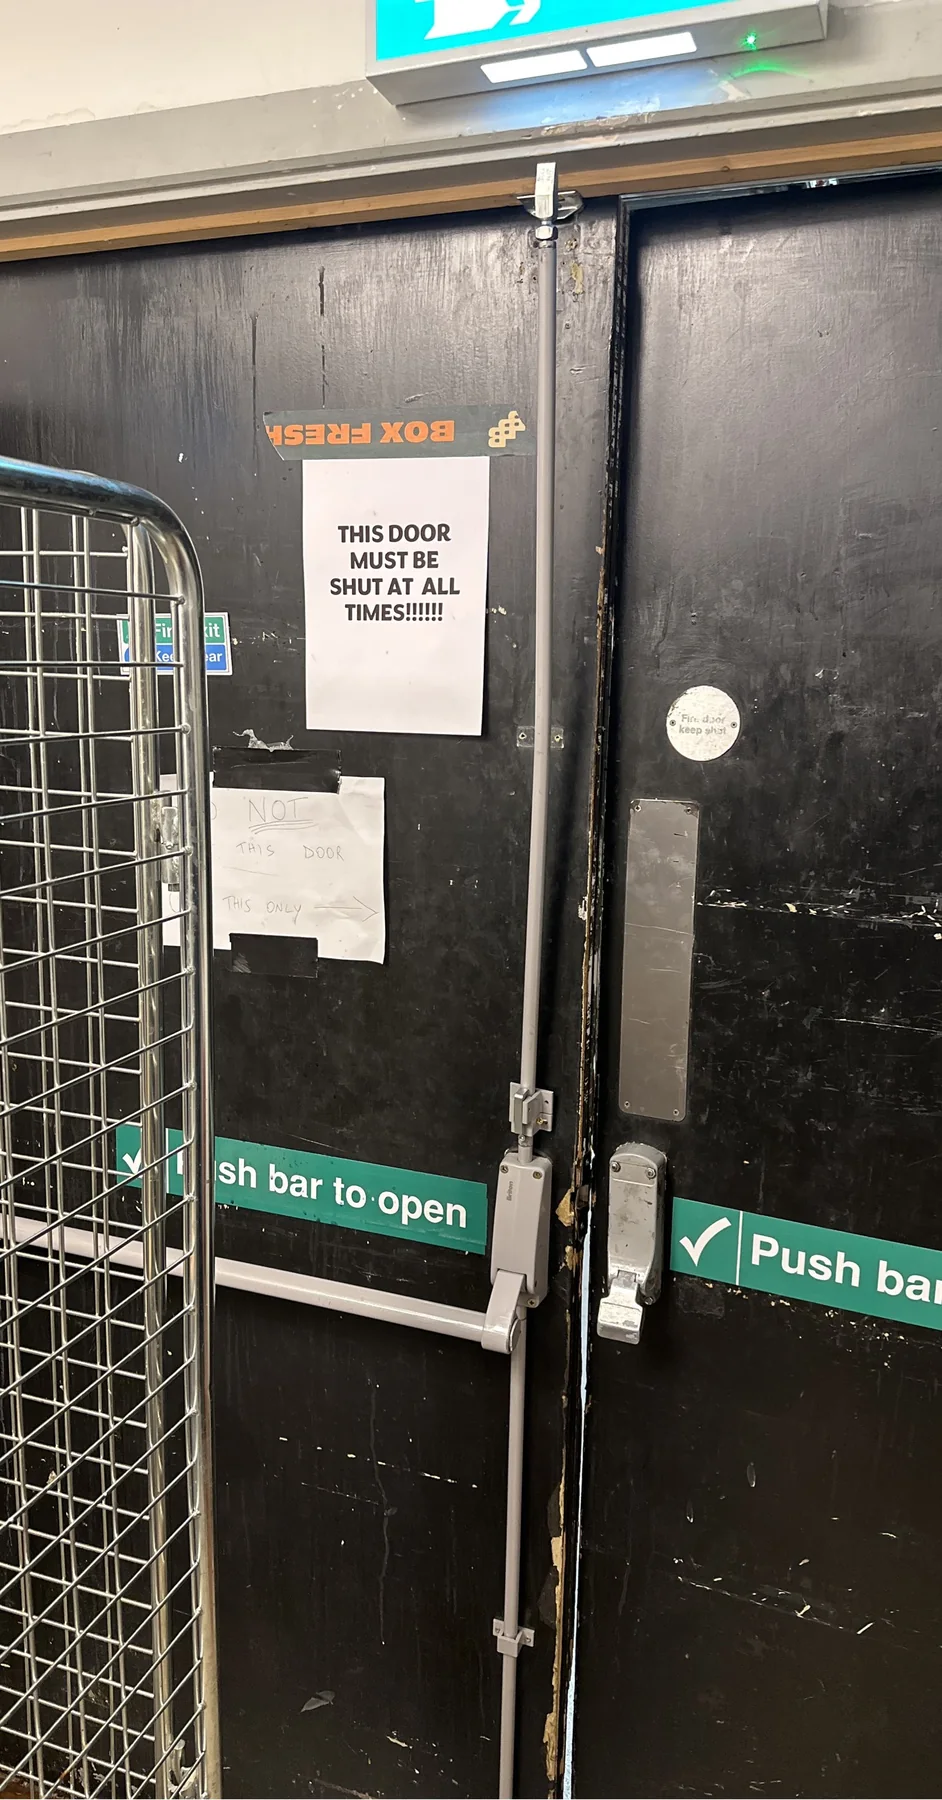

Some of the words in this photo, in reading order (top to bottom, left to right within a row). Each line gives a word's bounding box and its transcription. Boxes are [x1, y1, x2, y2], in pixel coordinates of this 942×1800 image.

[265, 422, 372, 446] FRESH
[380, 420, 455, 445] BOX
[338, 525, 384, 543] THIS
[388, 523, 451, 542] DOOR
[350, 551, 408, 570] MUST
[413, 551, 439, 569] BE
[329, 577, 383, 596] SHUT
[387, 578, 414, 595] AT
[421, 577, 461, 595] ALL
[344, 602, 444, 621] TIMES!!!!!!
[678, 725, 702, 736] keep
[248, 797, 309, 822] NOT
[236, 841, 275, 857] THIS
[303, 845, 345, 861] DOOR
[222, 895, 251, 913] THIS
[266, 901, 302, 925] ONLY
[268, 1164, 323, 1199] bar
[333, 1177, 367, 1208] to
[377, 1190, 467, 1228] open
[751, 1233, 861, 1288] Push
